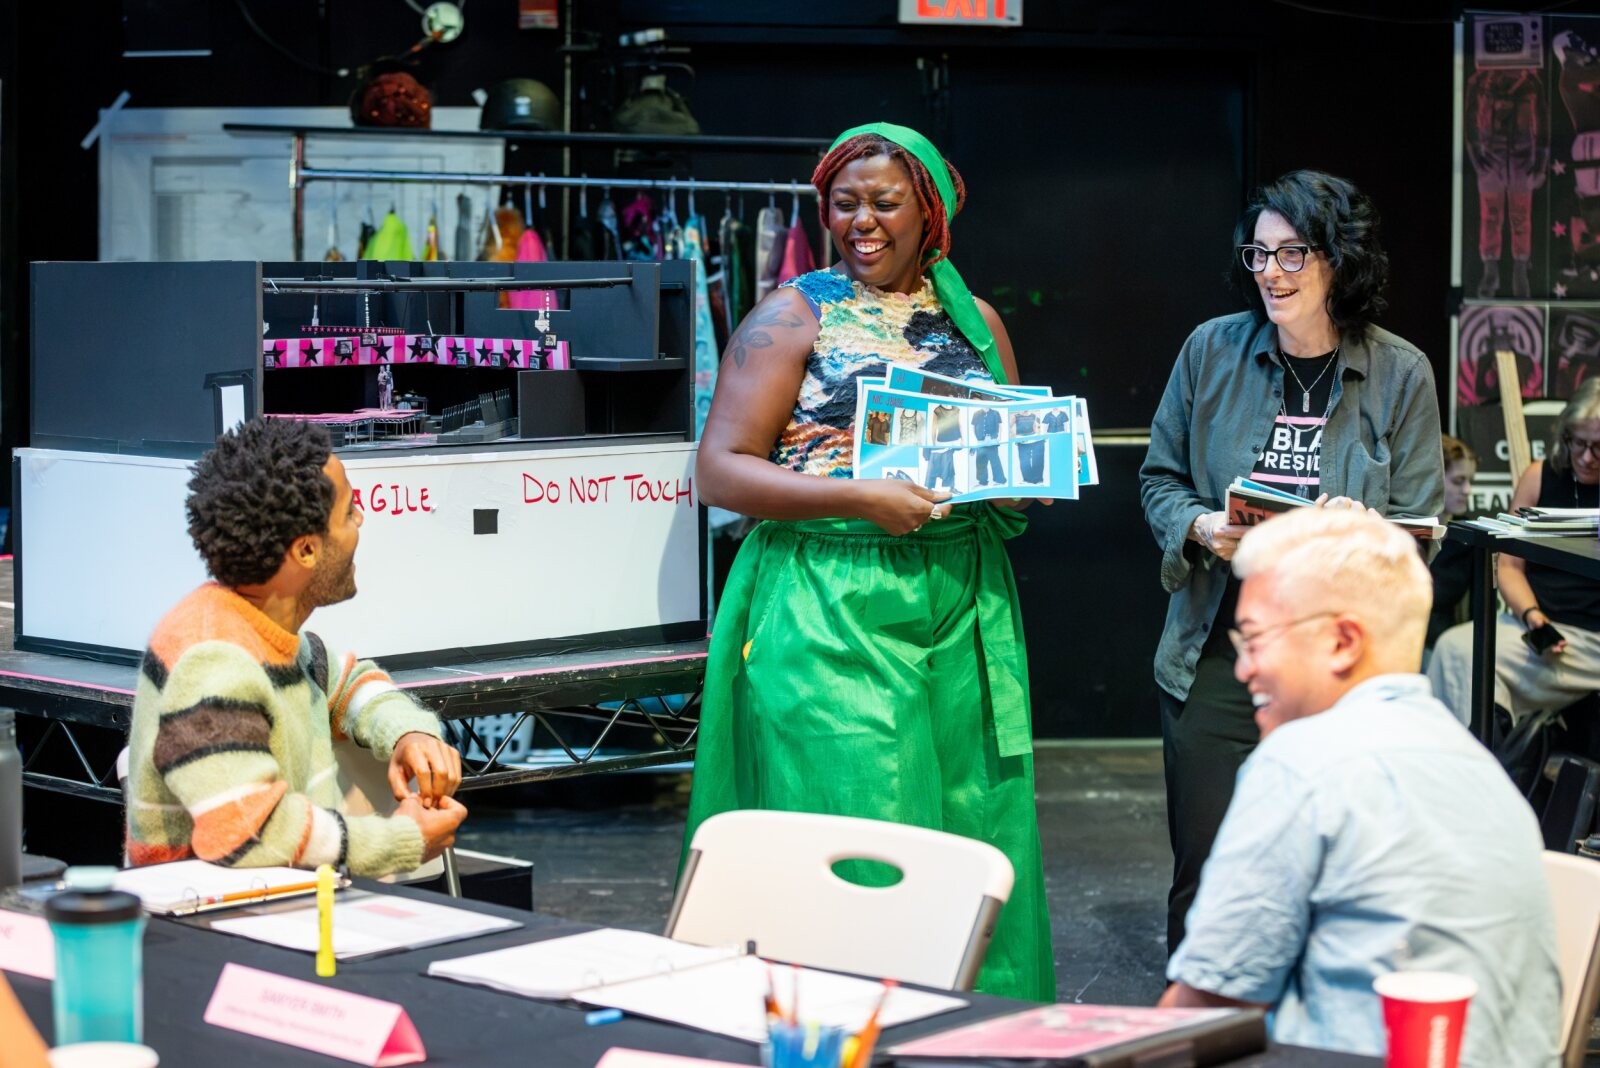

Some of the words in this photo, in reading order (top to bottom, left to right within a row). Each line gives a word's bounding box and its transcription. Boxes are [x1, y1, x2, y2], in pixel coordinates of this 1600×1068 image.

[522, 473, 561, 503] DO
[570, 475, 616, 504] NOT
[623, 474, 693, 507] TOUCH
